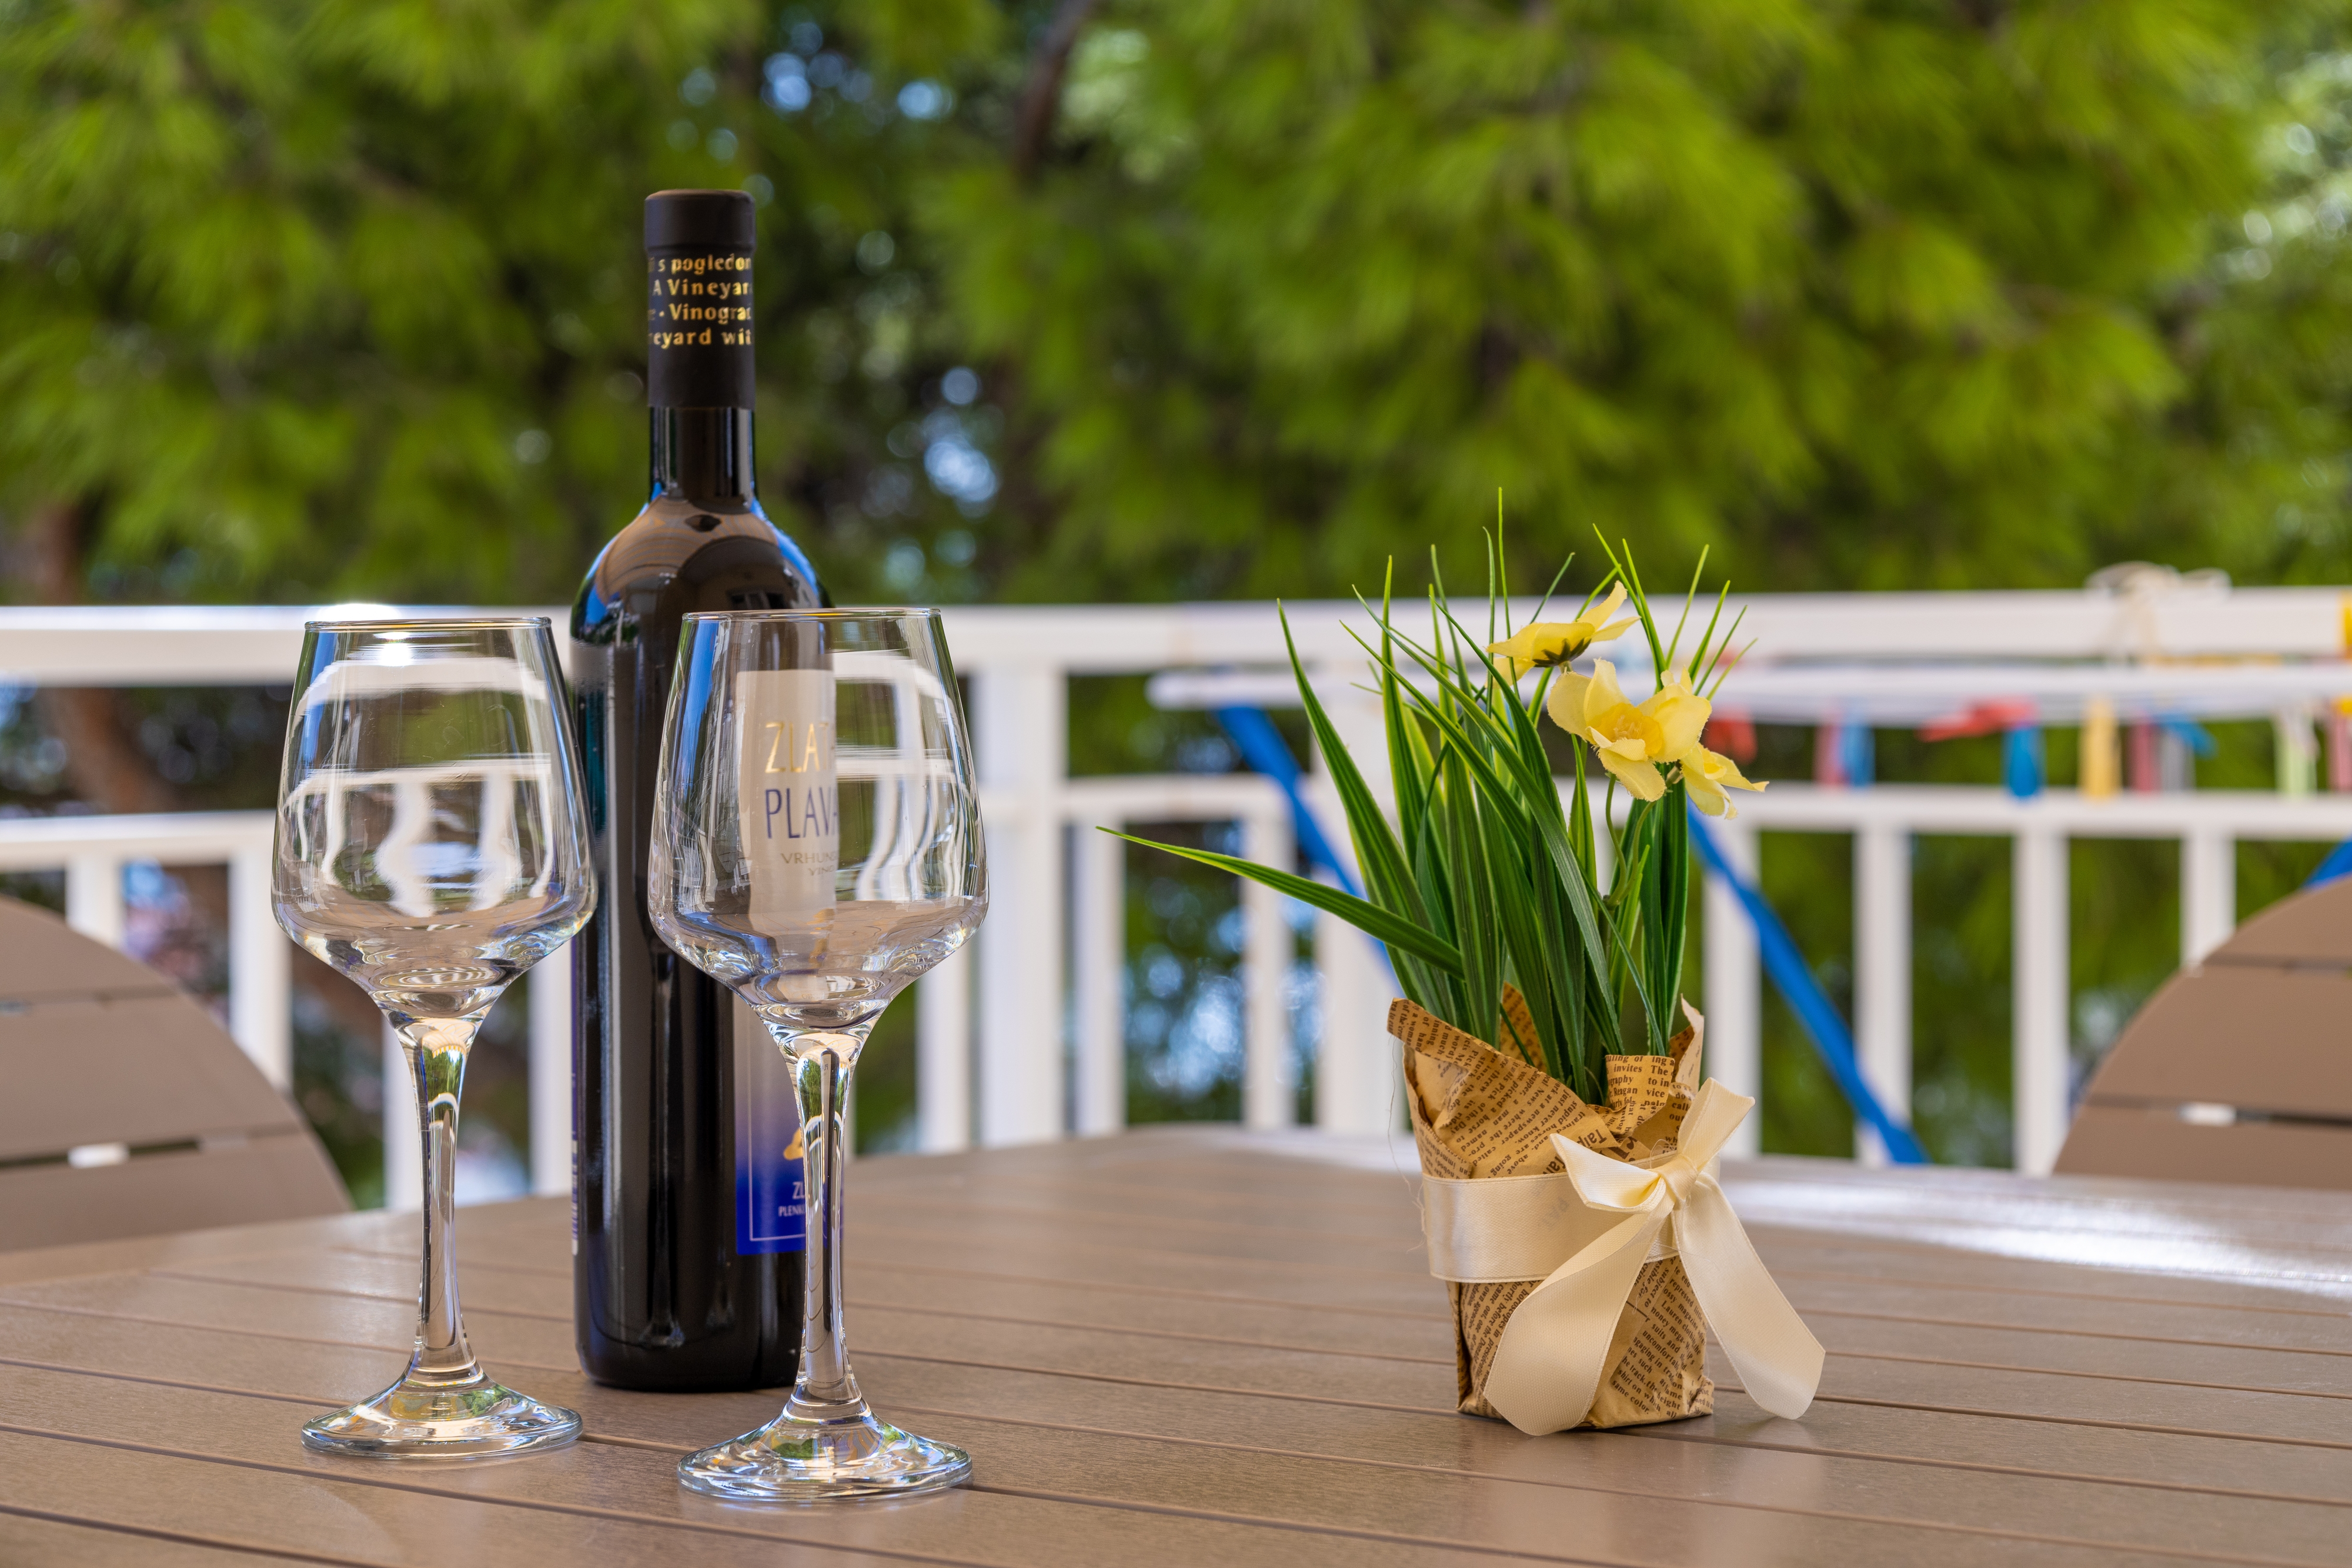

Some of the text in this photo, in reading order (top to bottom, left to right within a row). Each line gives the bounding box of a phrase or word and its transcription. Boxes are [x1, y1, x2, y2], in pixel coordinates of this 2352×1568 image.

[653, 279, 662, 296] A
[649, 327, 711, 349] eyard
[1415, 1017, 1430, 1054] of hand
[1436, 1032, 1449, 1055] much
[1463, 1049, 1479, 1066] Pick
[1468, 1056, 1486, 1078] stuck
[1476, 1065, 1492, 1081] into
[1614, 1064, 1642, 1072] invites
[1651, 1065, 1668, 1075] The
[1461, 1084, 1474, 1096] the
[1479, 1070, 1500, 1093] threw
[1648, 1077, 1658, 1085] to
[1488, 1082, 1505, 1100] Pick
[1496, 1080, 1519, 1108] picked
[1526, 1088, 1545, 1106] News
[1544, 1094, 1552, 1104] at
[1613, 1088, 1638, 1096] Reagan
[1646, 1089, 1665, 1098] vice
[1464, 1099, 1475, 1109] its
[1477, 1102, 1486, 1112] of
[1558, 1101, 1577, 1125] stupid
[1465, 1109, 1478, 1121] the
[1468, 1114, 1491, 1134] horse
[1493, 1109, 1509, 1126] man
[1503, 1109, 1525, 1130] where
[1515, 1089, 1571, 1144] just never know.
[1556, 1111, 1586, 1134] trained
[1450, 1121, 1467, 1134] Day
[1489, 1129, 1503, 1141] the
[1501, 1109, 1540, 1145] newspaper
[1531, 1124, 1558, 1143] horses
[1461, 1129, 1487, 1152] named
[1468, 1141, 1485, 1156] pro-
[1515, 1144, 1529, 1155] are
[1472, 1146, 1496, 1167] called
[1490, 1154, 1512, 1176] going
[1506, 1154, 1528, 1175] above
[1478, 1286, 1489, 1302] own
[1489, 1283, 1504, 1304] came
[1502, 1281, 1523, 1303] hortly
[1645, 1268, 1669, 1308] subject to
[1669, 1279, 1694, 1308] repressed
[1489, 1302, 1507, 1326] before
[1661, 1300, 1682, 1325] Lauren
[1678, 1303, 1698, 1330] magazine
[1475, 1319, 1483, 1333] one
[1482, 1325, 1492, 1338] the
[1493, 1329, 1502, 1338] in
[1669, 1326, 1685, 1343] mega-
[1651, 1323, 1666, 1340] suits
[1666, 1340, 1681, 1353] and
[1621, 1356, 1631, 1367] he
[1638, 1358, 1652, 1374] such
[1654, 1358, 1663, 1368] in
[1616, 1368, 1633, 1385] shirt
[1632, 1384, 1642, 1395] on
[1612, 1380, 1649, 1415] same color.
